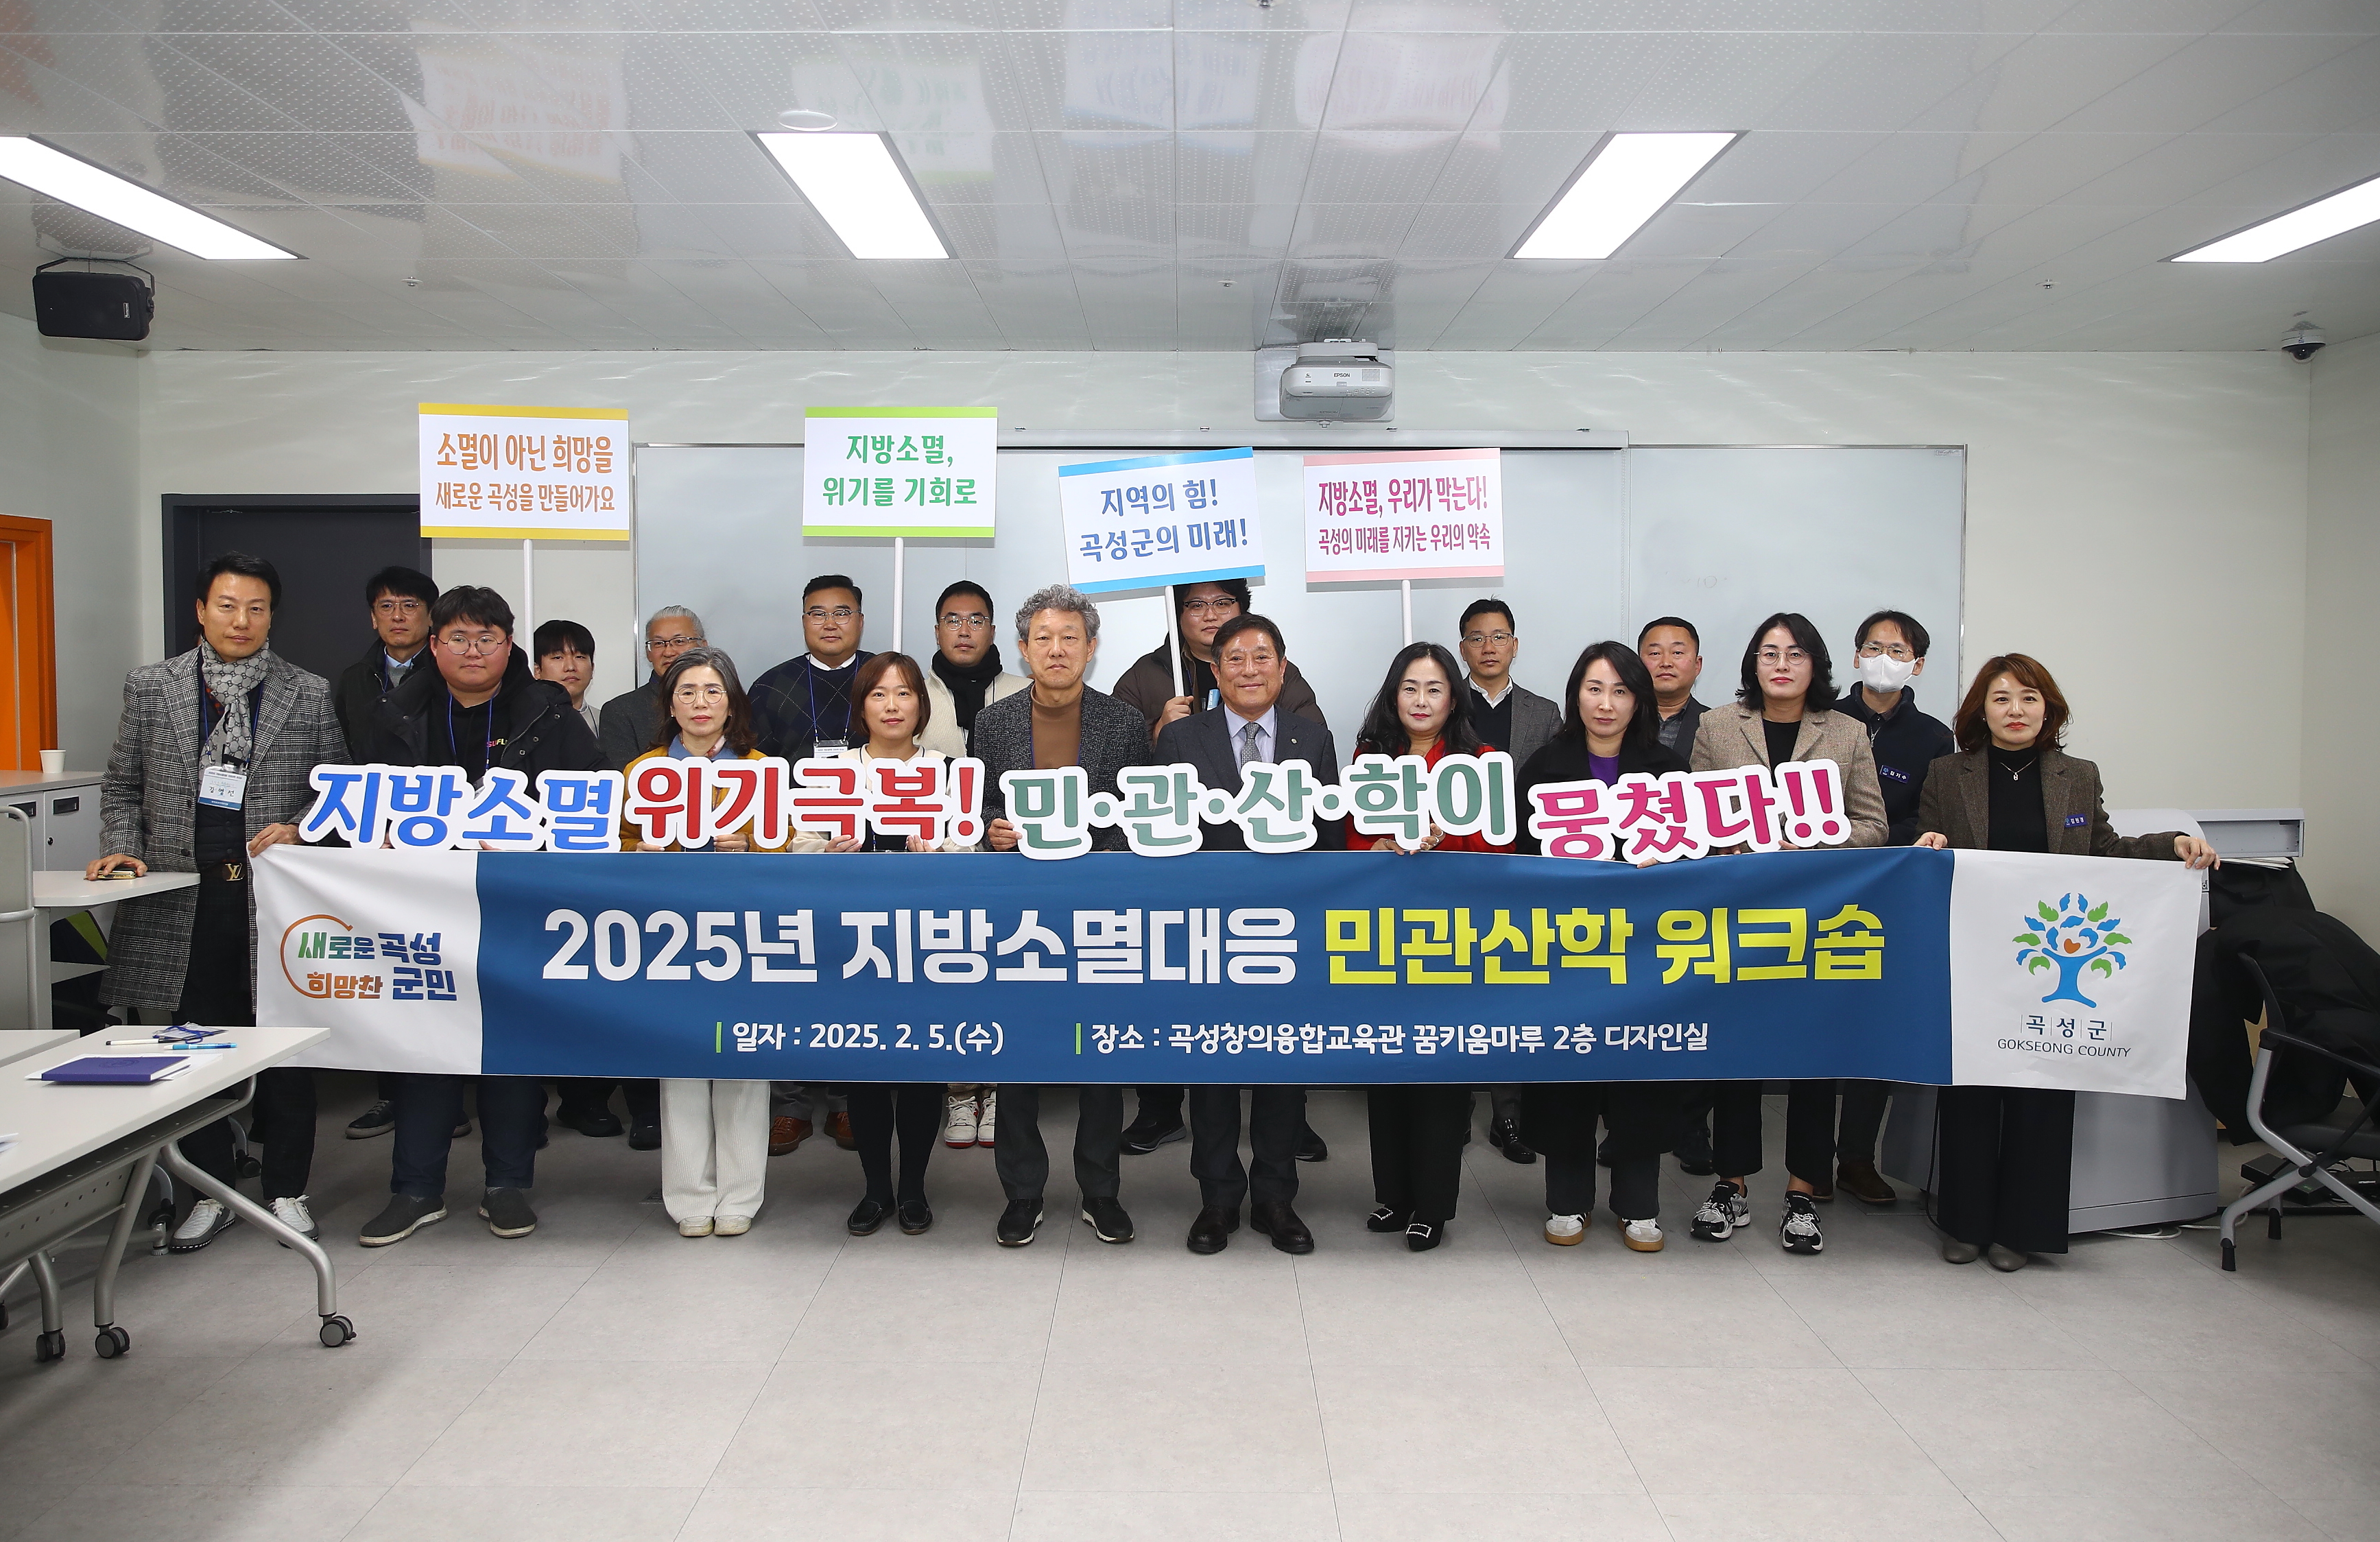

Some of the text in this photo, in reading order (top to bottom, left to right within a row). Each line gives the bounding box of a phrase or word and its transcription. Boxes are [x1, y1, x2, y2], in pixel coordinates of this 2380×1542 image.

[436, 432, 612, 473] 소멸이 아닌 희망을
[846, 434, 953, 467] 지방소멸,
[436, 482, 614, 512] 새로운 곡성을 만들어가요
[823, 477, 977, 506] 위기를 기회로
[1100, 478, 1218, 517] 지역의 힘!
[1318, 475, 1488, 518] 지방소멸, 우리가 막는다!
[1080, 519, 1248, 562] 곡성군의 미래!
[1318, 523, 1490, 556] 곡성의 미래를 지키는 우리의 약속
[307, 772, 612, 851] 지방소멸
[634, 767, 974, 840] 위기극복!
[1536, 768, 1833, 859] 뭉쳤다!!
[298, 932, 442, 966] 새로운 곡성
[542, 905, 1884, 984] 2025년 지방소멸대응 민관산학 워크숍
[306, 966, 457, 1001] 희망찬 군민
[733, 1022, 787, 1052] 일자
[809, 1023, 886, 1050] 2025.
[895, 1023, 920, 1050] 2.
[928, 1021, 1003, 1056] 5.(수)
[1091, 1024, 1145, 1054] 장소
[1168, 1022, 1406, 1054] 곡성창의융합교육관
[1412, 1024, 1545, 1054] 꿈키움마루
[1554, 1023, 1597, 1054] 2층
[1605, 1022, 1708, 1052] 디자인실
[1997, 1039, 2132, 1058] GOKSEONG COUNTY
